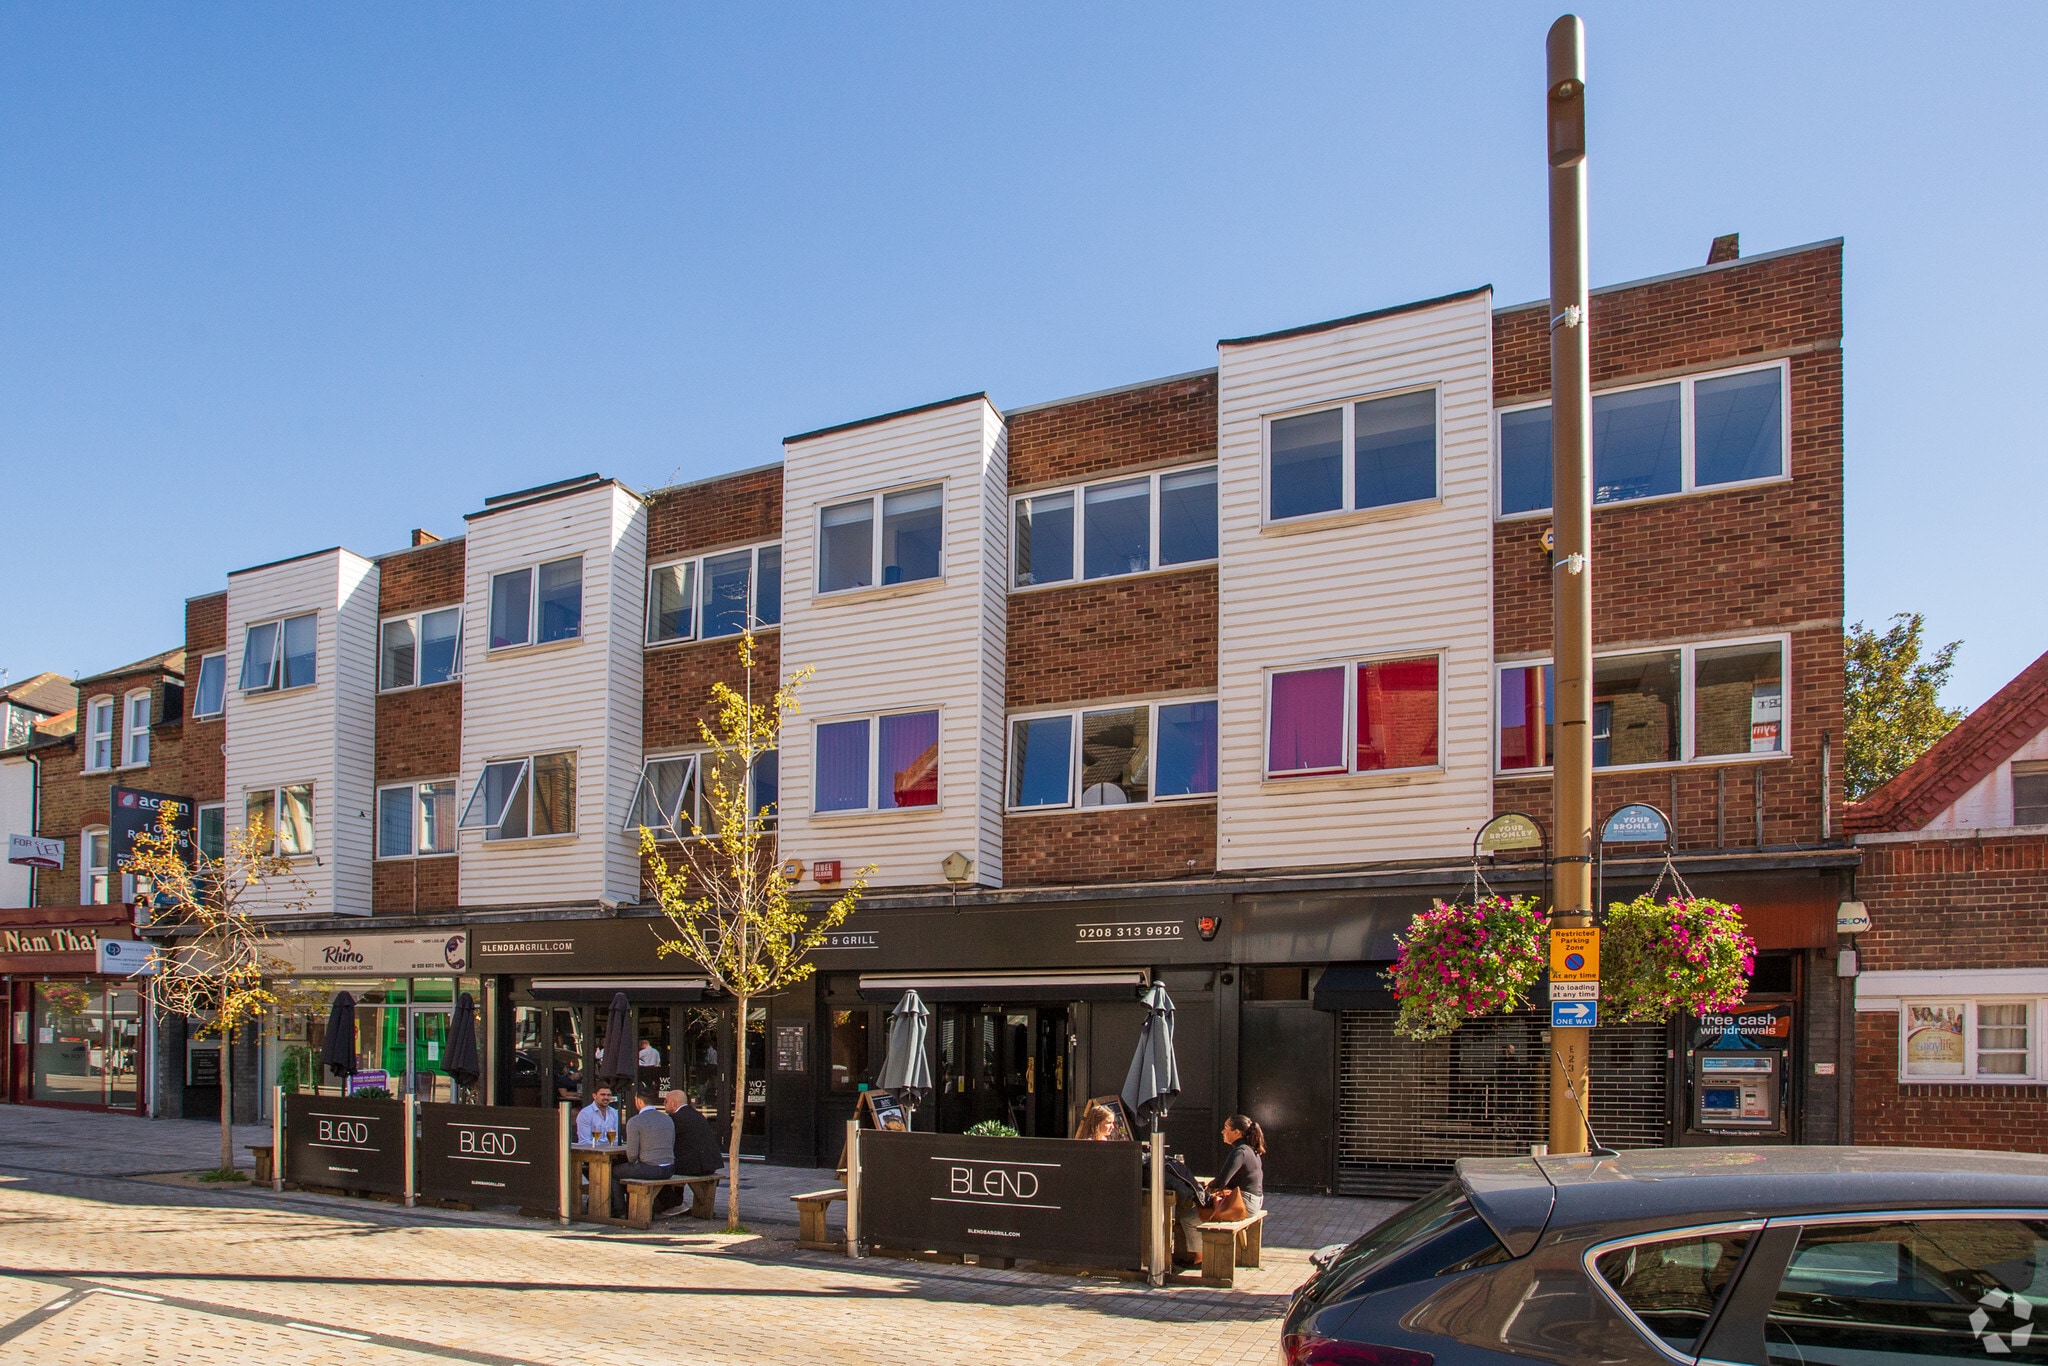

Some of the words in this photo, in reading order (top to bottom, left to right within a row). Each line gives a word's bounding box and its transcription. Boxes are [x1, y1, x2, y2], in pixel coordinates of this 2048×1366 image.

[1623, 816, 1650, 824] YOUR
[1498, 824, 1524, 833] YOUR
[1613, 822, 1659, 830] BROMLEY
[1489, 830, 1533, 840] BROMLEY
[13, 837, 32, 847] FOR
[36, 843, 61, 857] LET
[814, 863, 834, 872] ABEL
[1079, 928, 1112, 938] 0208
[1116, 927, 1142, 937] 313
[1146, 925, 1180, 936] 9620
[4, 930, 52, 953] Nam
[51, 928, 97, 952] Thai
[831, 936, 839, 945] &
[842, 935, 876, 945] GRILL
[322, 940, 364, 965] Rhino
[482, 942, 573, 953] BLENDBARGRILL.COM
[1566, 984, 1595, 992] loading
[1700, 1013, 1734, 1026] free
[1738, 1013, 1777, 1026] cash
[1700, 1025, 1777, 1035] withdrawals
[319, 1120, 368, 1144] BLEND
[460, 1130, 517, 1156] BLEND
[951, 1167, 1039, 1199] BLEND
[967, 1228, 1021, 1238] BLENDBARGRILL.COM
